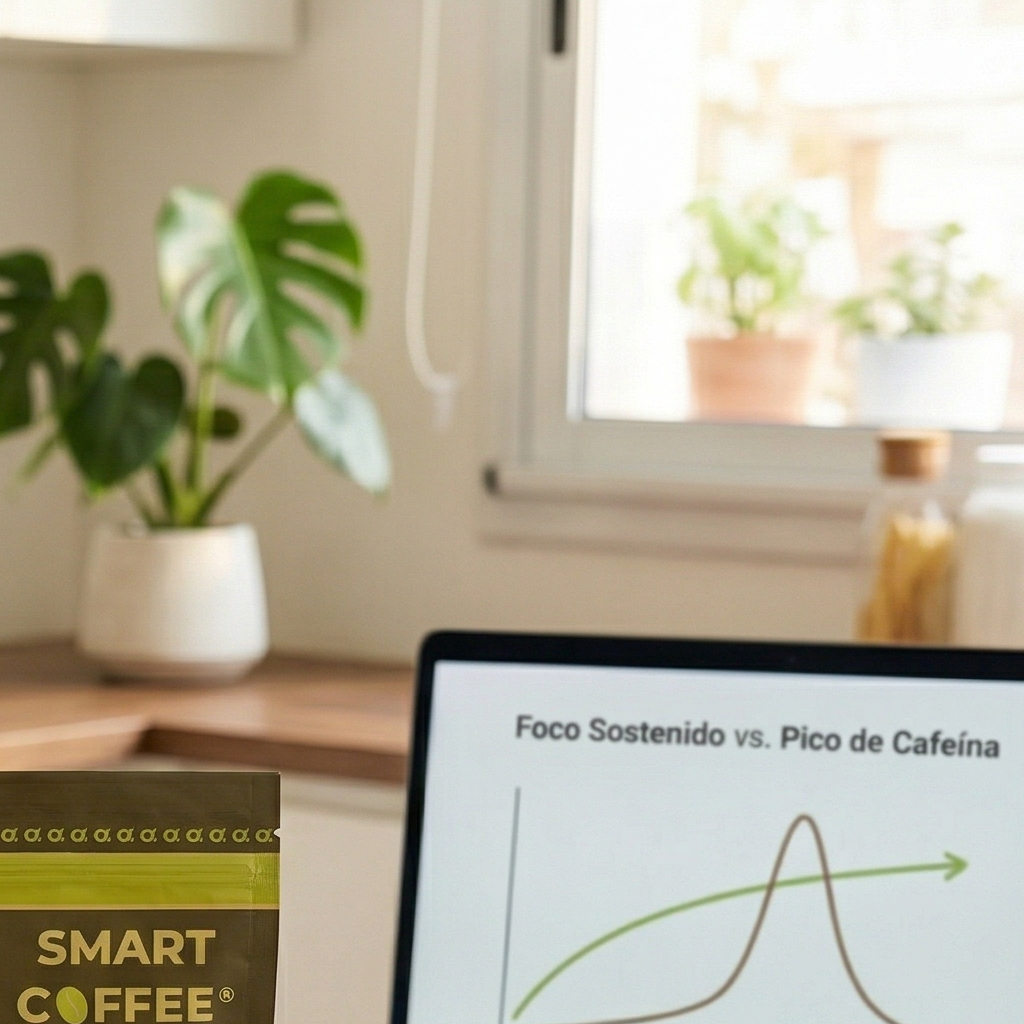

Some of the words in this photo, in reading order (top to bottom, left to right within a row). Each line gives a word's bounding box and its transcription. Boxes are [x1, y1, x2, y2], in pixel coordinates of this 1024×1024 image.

[515, 714, 581, 741] Foco
[588, 717, 726, 747] Sostenido
[734, 729, 771, 749] vs.
[780, 725, 841, 751] Pico
[849, 727, 884, 754] de
[892, 730, 1000, 758] Cafeína
[37, 929, 216, 966] SMART
